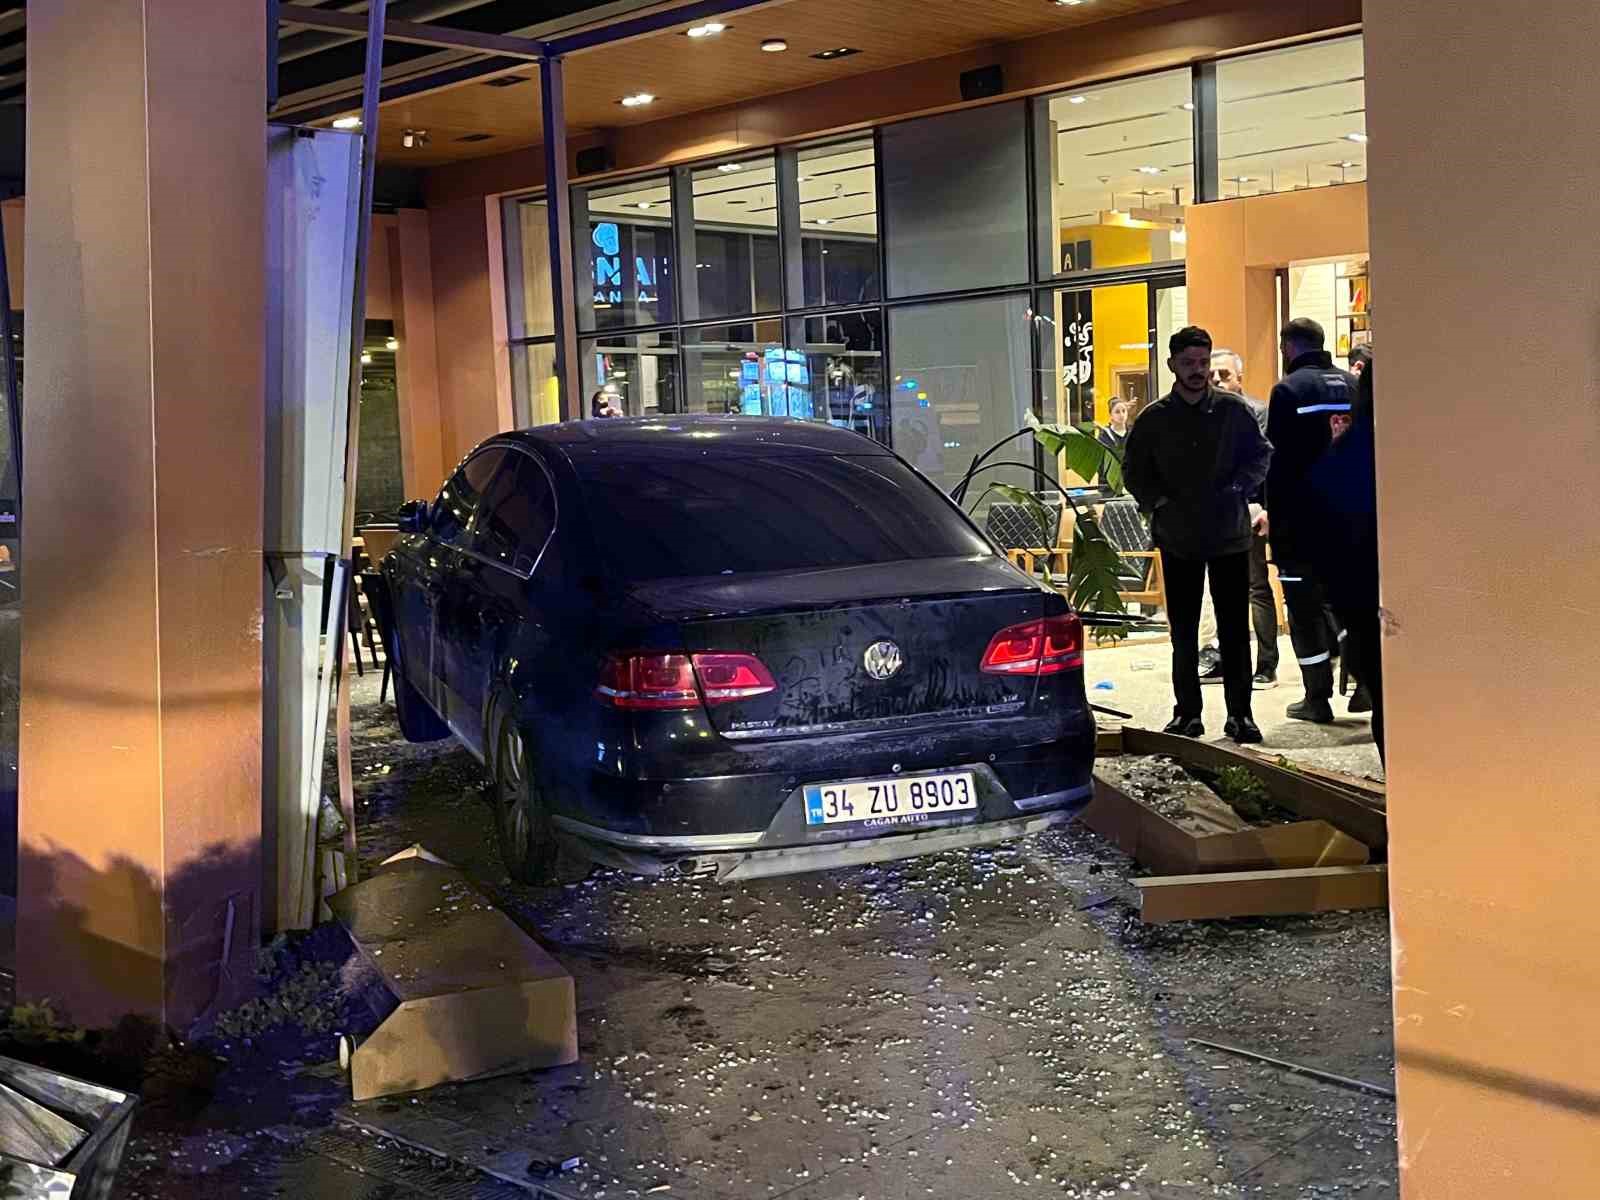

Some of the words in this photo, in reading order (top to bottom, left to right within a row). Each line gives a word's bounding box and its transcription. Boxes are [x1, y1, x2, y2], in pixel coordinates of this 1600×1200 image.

[824, 790, 853, 818] 34
[868, 785, 898, 814] ZU
[910, 778, 969, 810] 8903
[900, 813, 928, 824] AUTO
